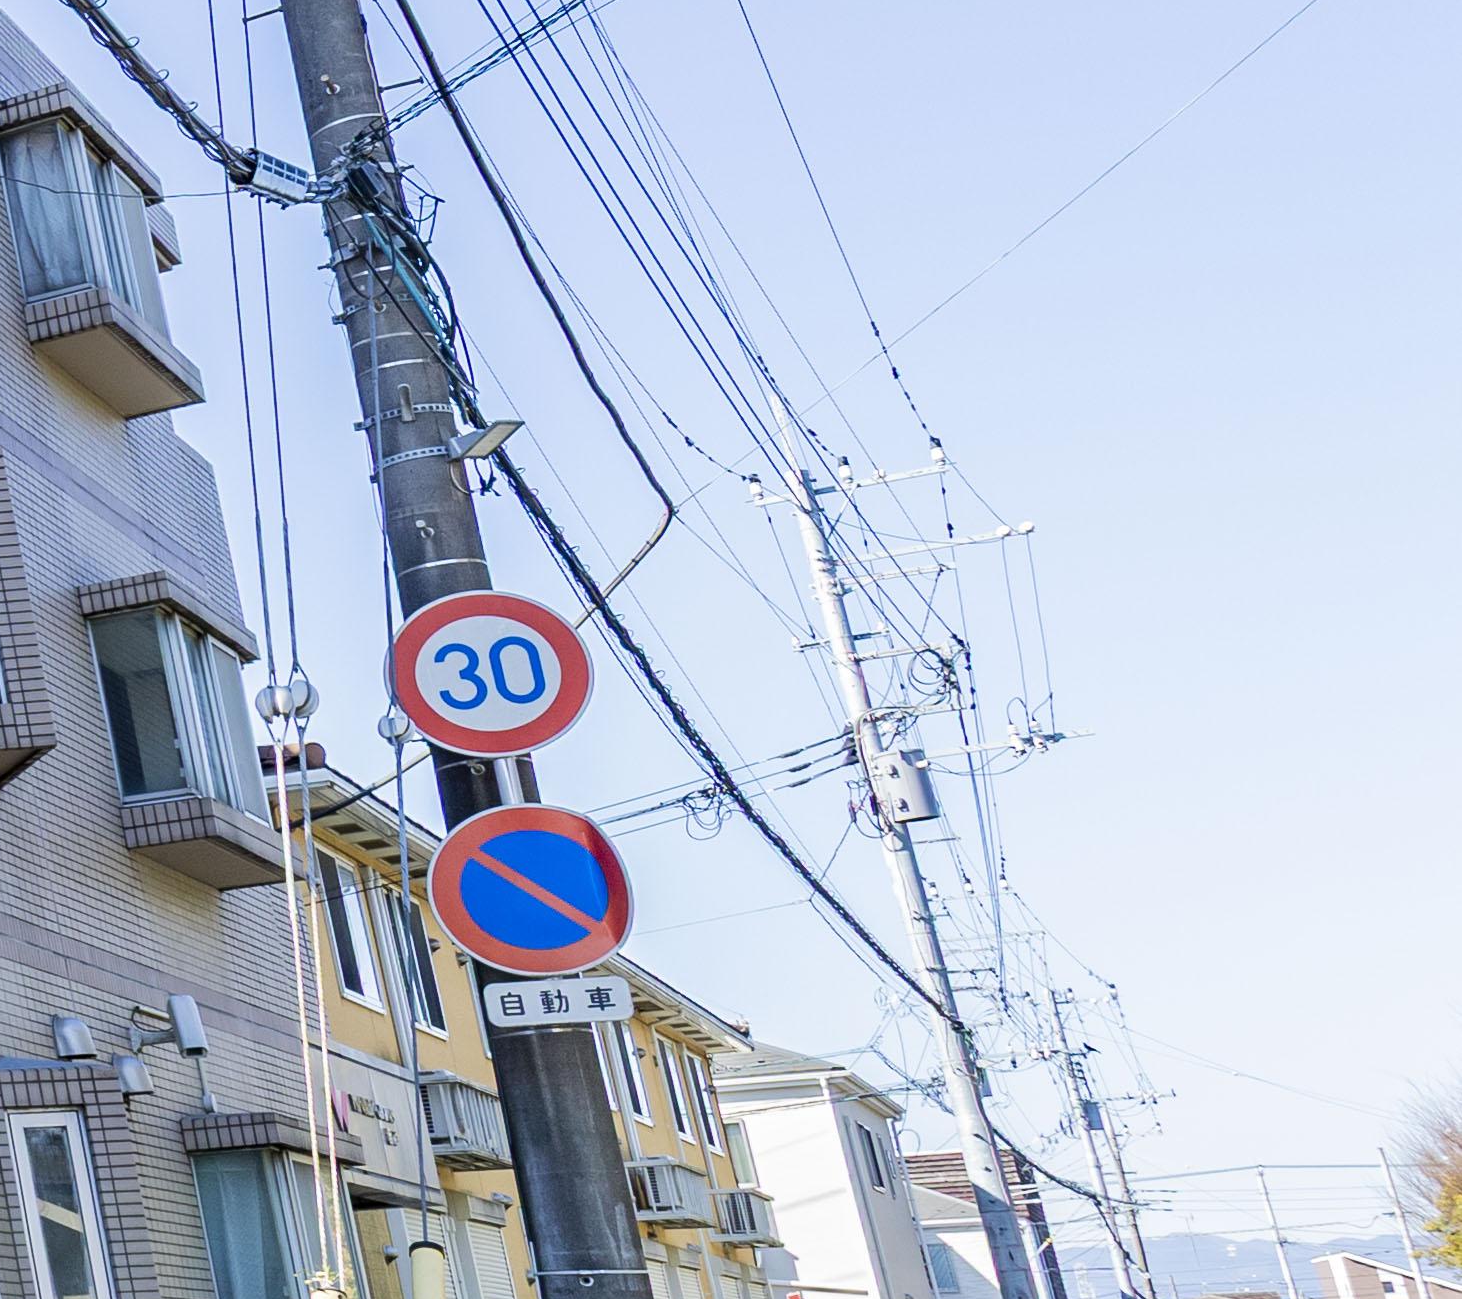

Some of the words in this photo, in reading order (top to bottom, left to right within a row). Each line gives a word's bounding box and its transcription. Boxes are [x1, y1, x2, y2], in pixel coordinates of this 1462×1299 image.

[434, 636, 546, 710] 30
[500, 986, 617, 1016] 自動車
